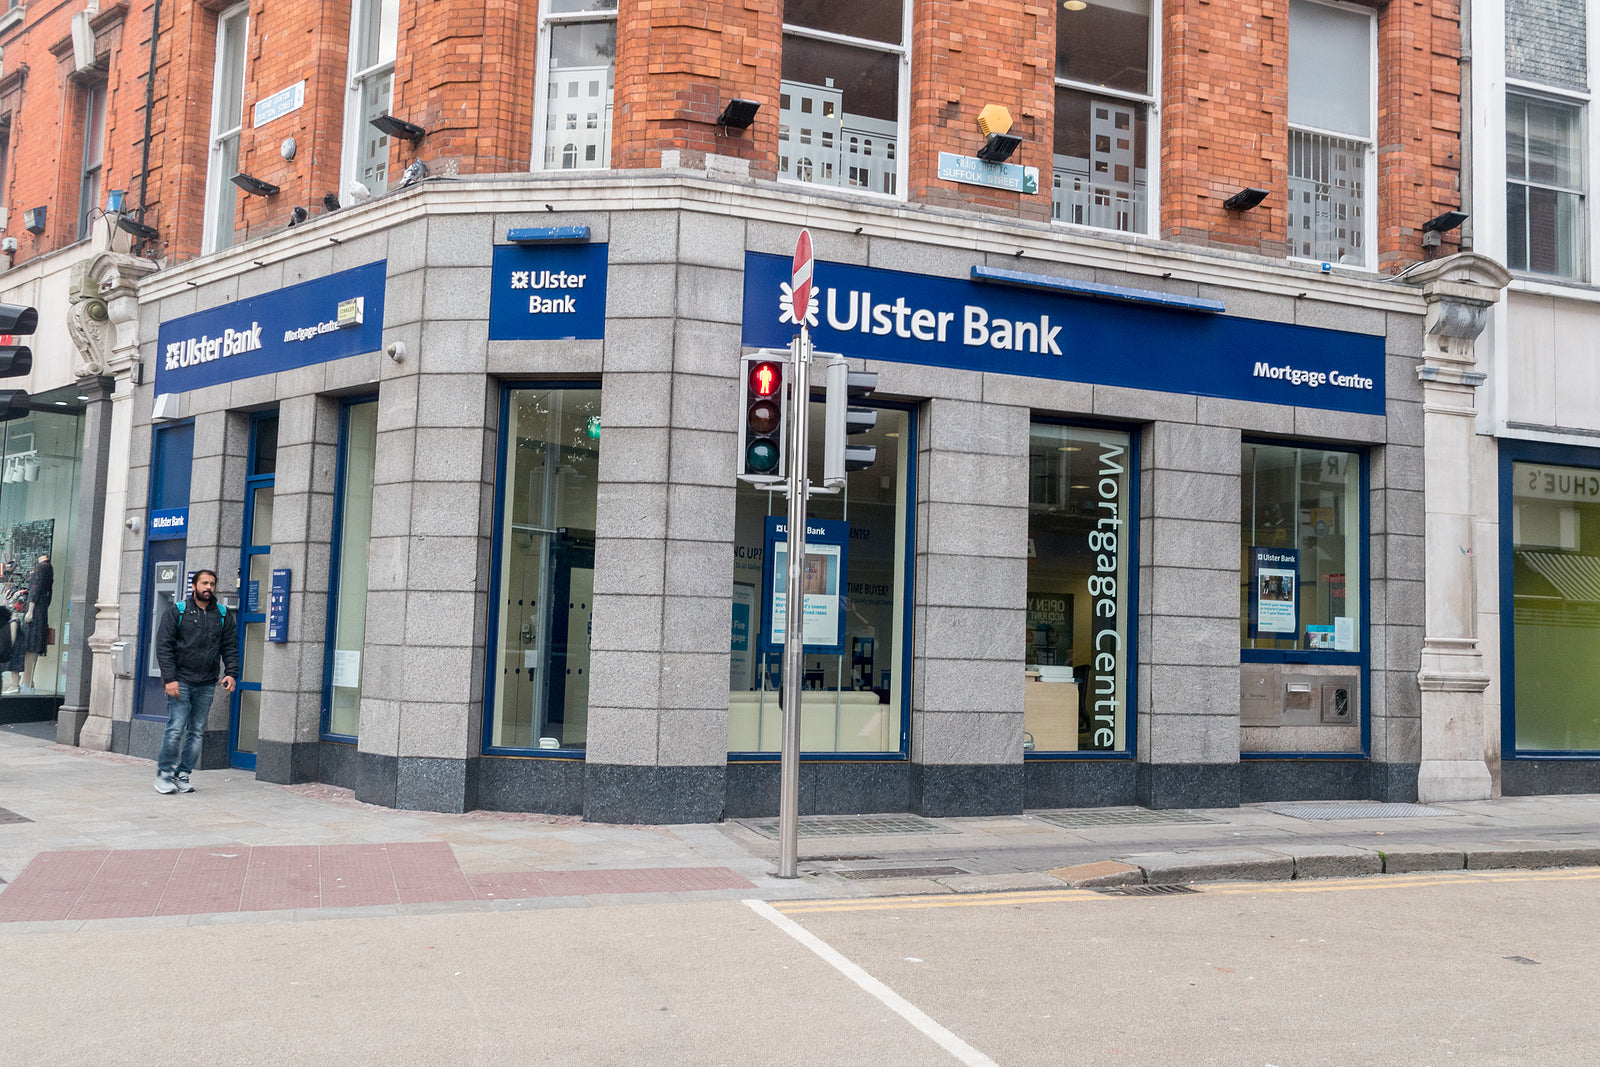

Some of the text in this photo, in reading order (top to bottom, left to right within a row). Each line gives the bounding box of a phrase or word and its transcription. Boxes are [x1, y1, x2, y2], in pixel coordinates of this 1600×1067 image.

[943, 168, 1020, 187] SUFFOLK STREET
[1026, 174, 1035, 187] 2
[530, 270, 586, 289] Ulster
[529, 295, 576, 313] Bank
[827, 287, 1063, 356] Ulster Bank
[284, 326, 318, 342] Mortgage
[180, 321, 262, 367] Ulster Bank
[1253, 361, 1373, 390] Mortgage Centre
[159, 515, 184, 527] Ulster Bank
[806, 526, 826, 535] Bank
[747, 547, 763, 560] UP?
[1263, 553, 1296, 562] Ulster Bank
[1088, 442, 1124, 748] Mortgage Centre
